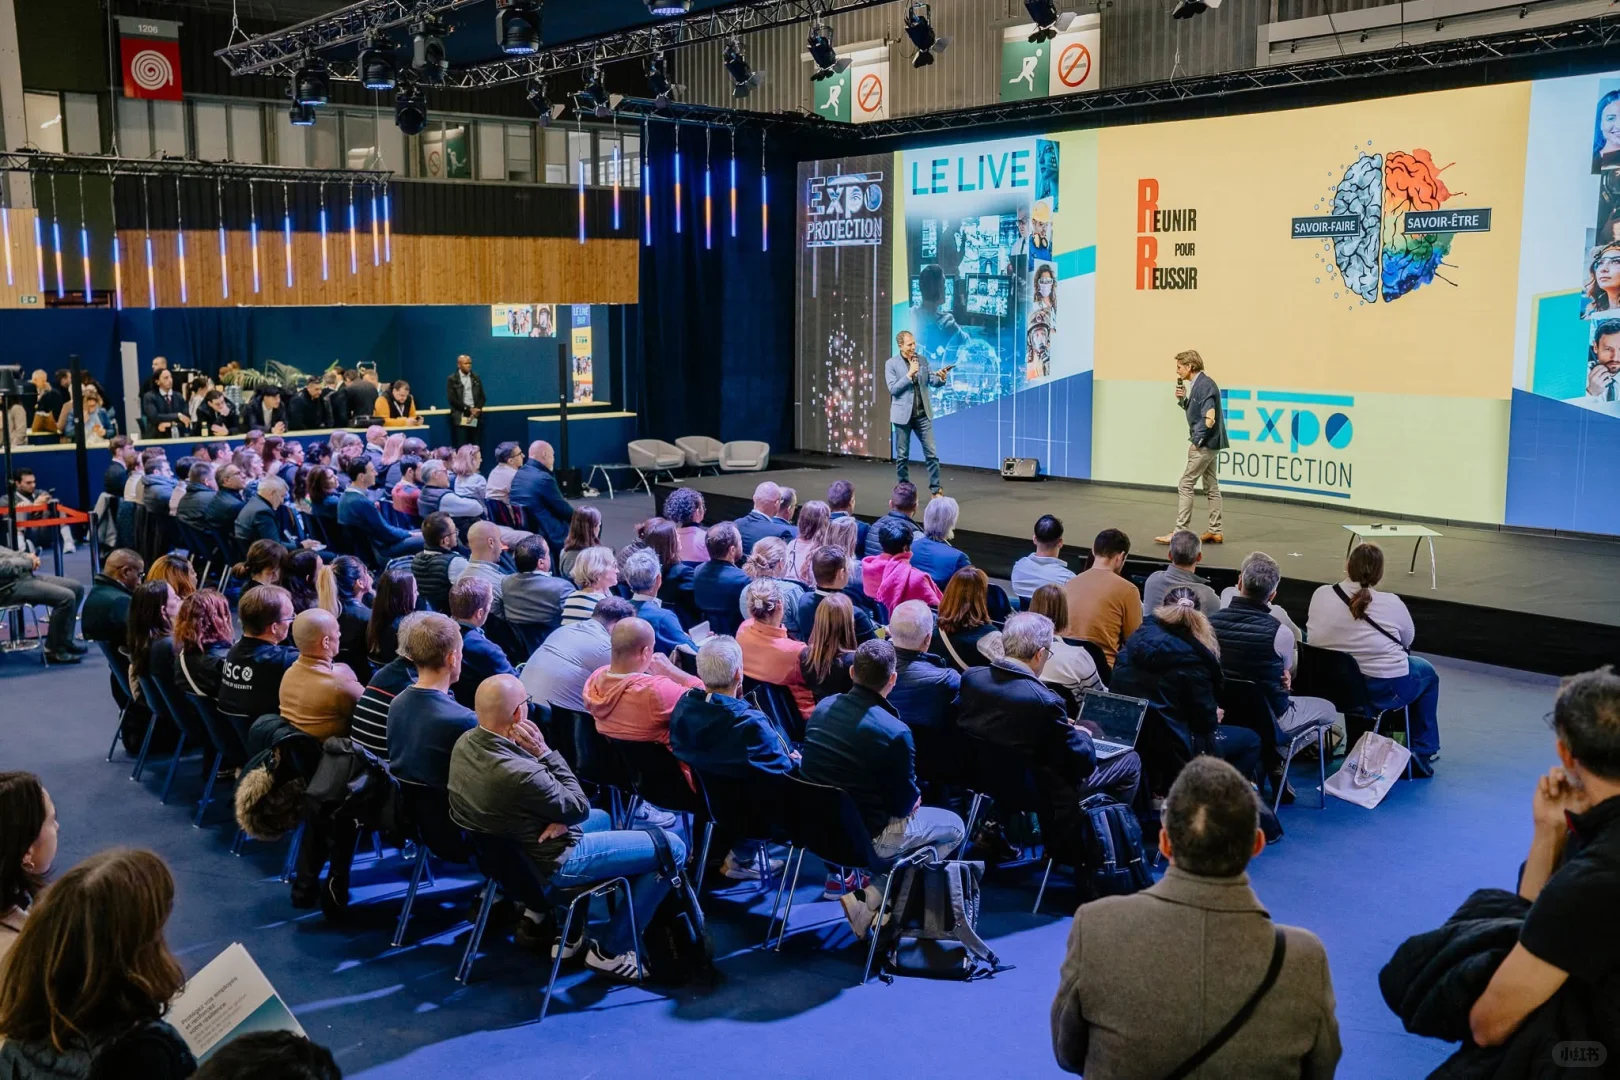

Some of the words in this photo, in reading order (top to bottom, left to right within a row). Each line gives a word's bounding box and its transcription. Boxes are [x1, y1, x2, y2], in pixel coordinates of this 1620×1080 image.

[912, 158, 949, 195] LE
[958, 149, 1030, 192] LIVE
[806, 217, 883, 240] PROTECTION
[1294, 220, 1356, 234] SAVOIR-FAIRE
[1407, 213, 1480, 229] SAVOIR-ÊTRE
[1174, 242, 1196, 257] POUR
[1217, 450, 1352, 489] PROTECTION
